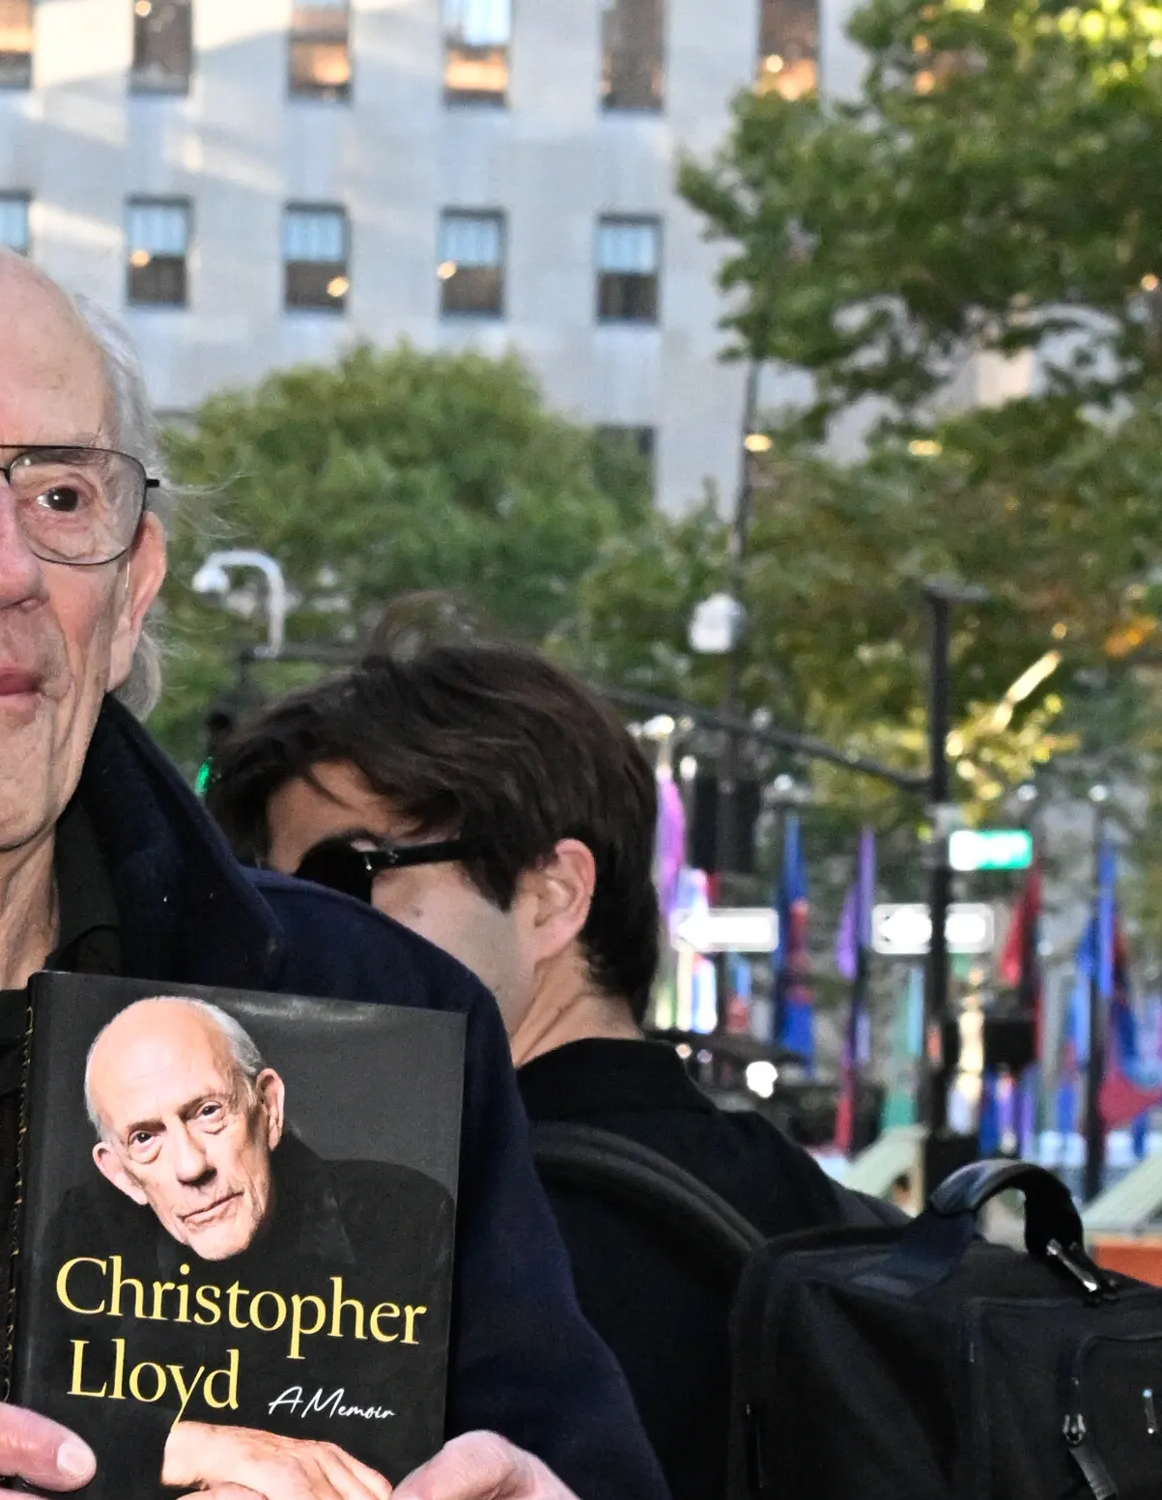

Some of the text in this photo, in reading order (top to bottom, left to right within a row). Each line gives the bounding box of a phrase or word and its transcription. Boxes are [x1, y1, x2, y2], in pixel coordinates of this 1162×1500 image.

[56, 1255, 427, 1360] Christopher
[67, 1338, 240, 1430] Lloyd
[268, 1385, 396, 1419] A Memoir
